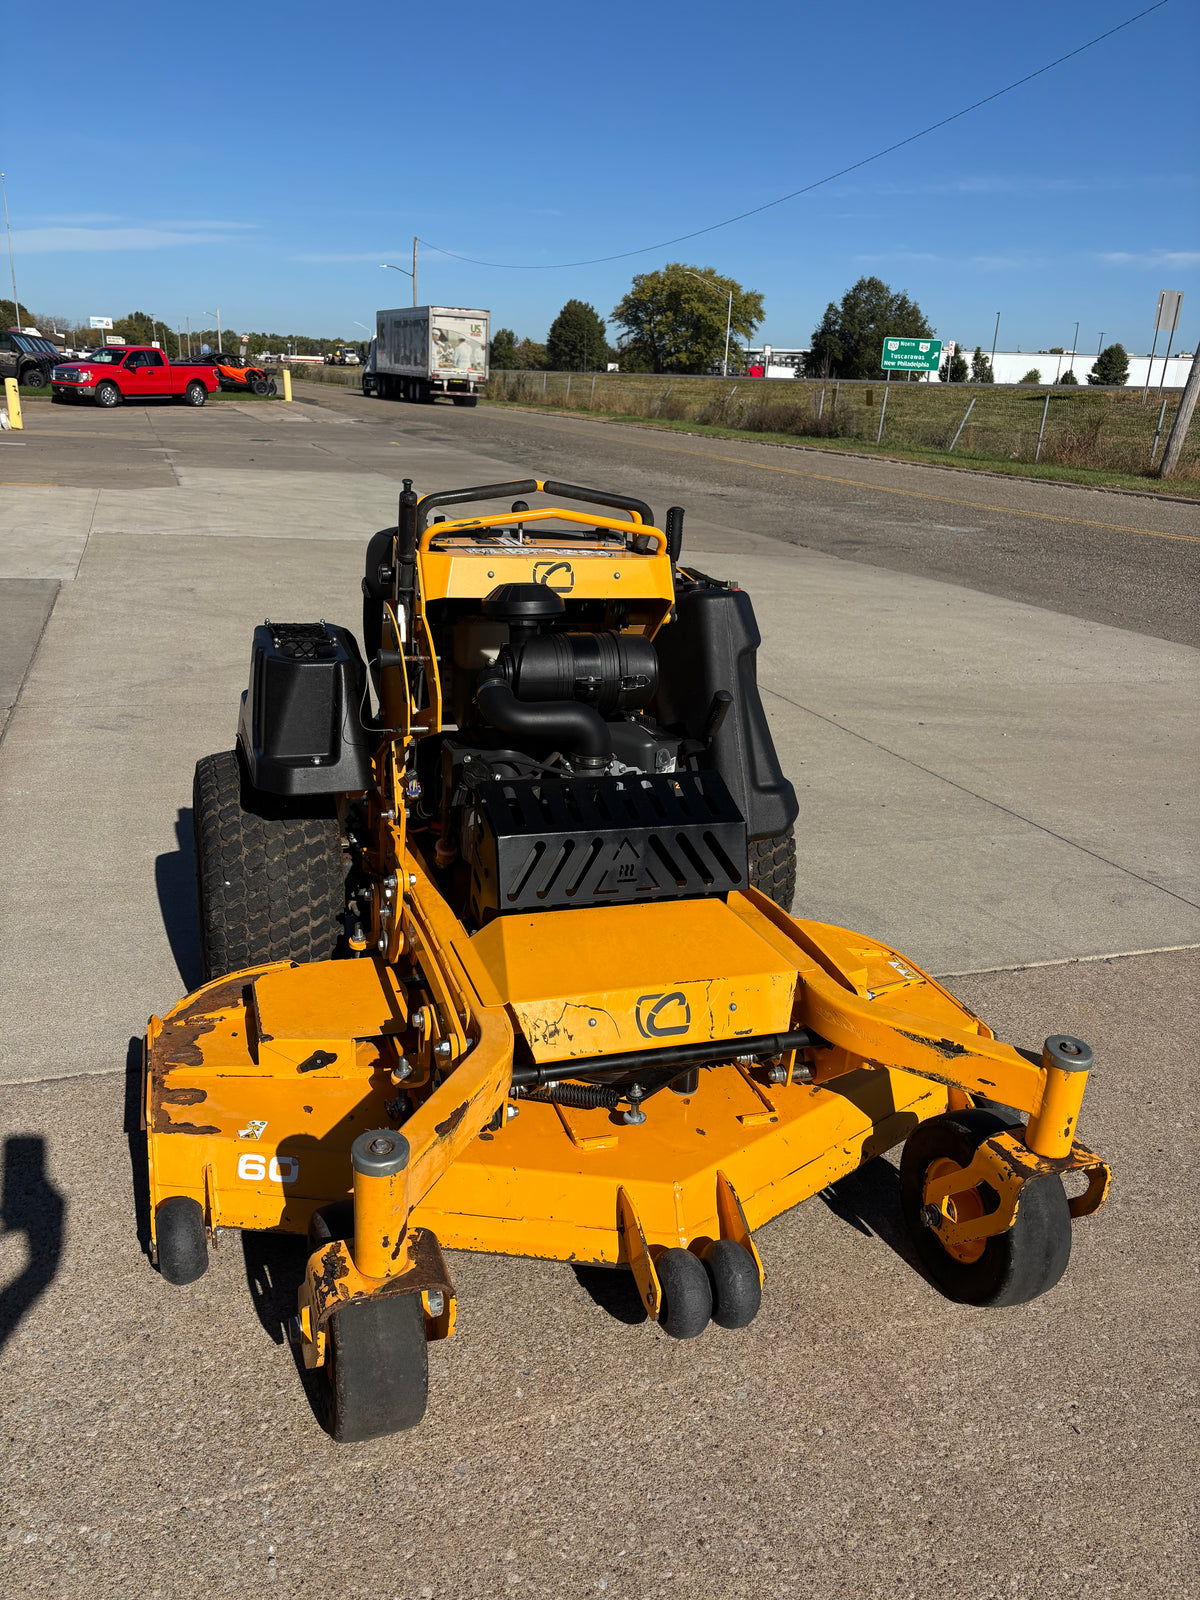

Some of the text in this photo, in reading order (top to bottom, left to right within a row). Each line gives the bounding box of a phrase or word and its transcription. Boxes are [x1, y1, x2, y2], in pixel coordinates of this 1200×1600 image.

[470, 324, 481, 333] US
[890, 353, 925, 361] Tuscarawas
[238, 1153, 299, 1183] 60
